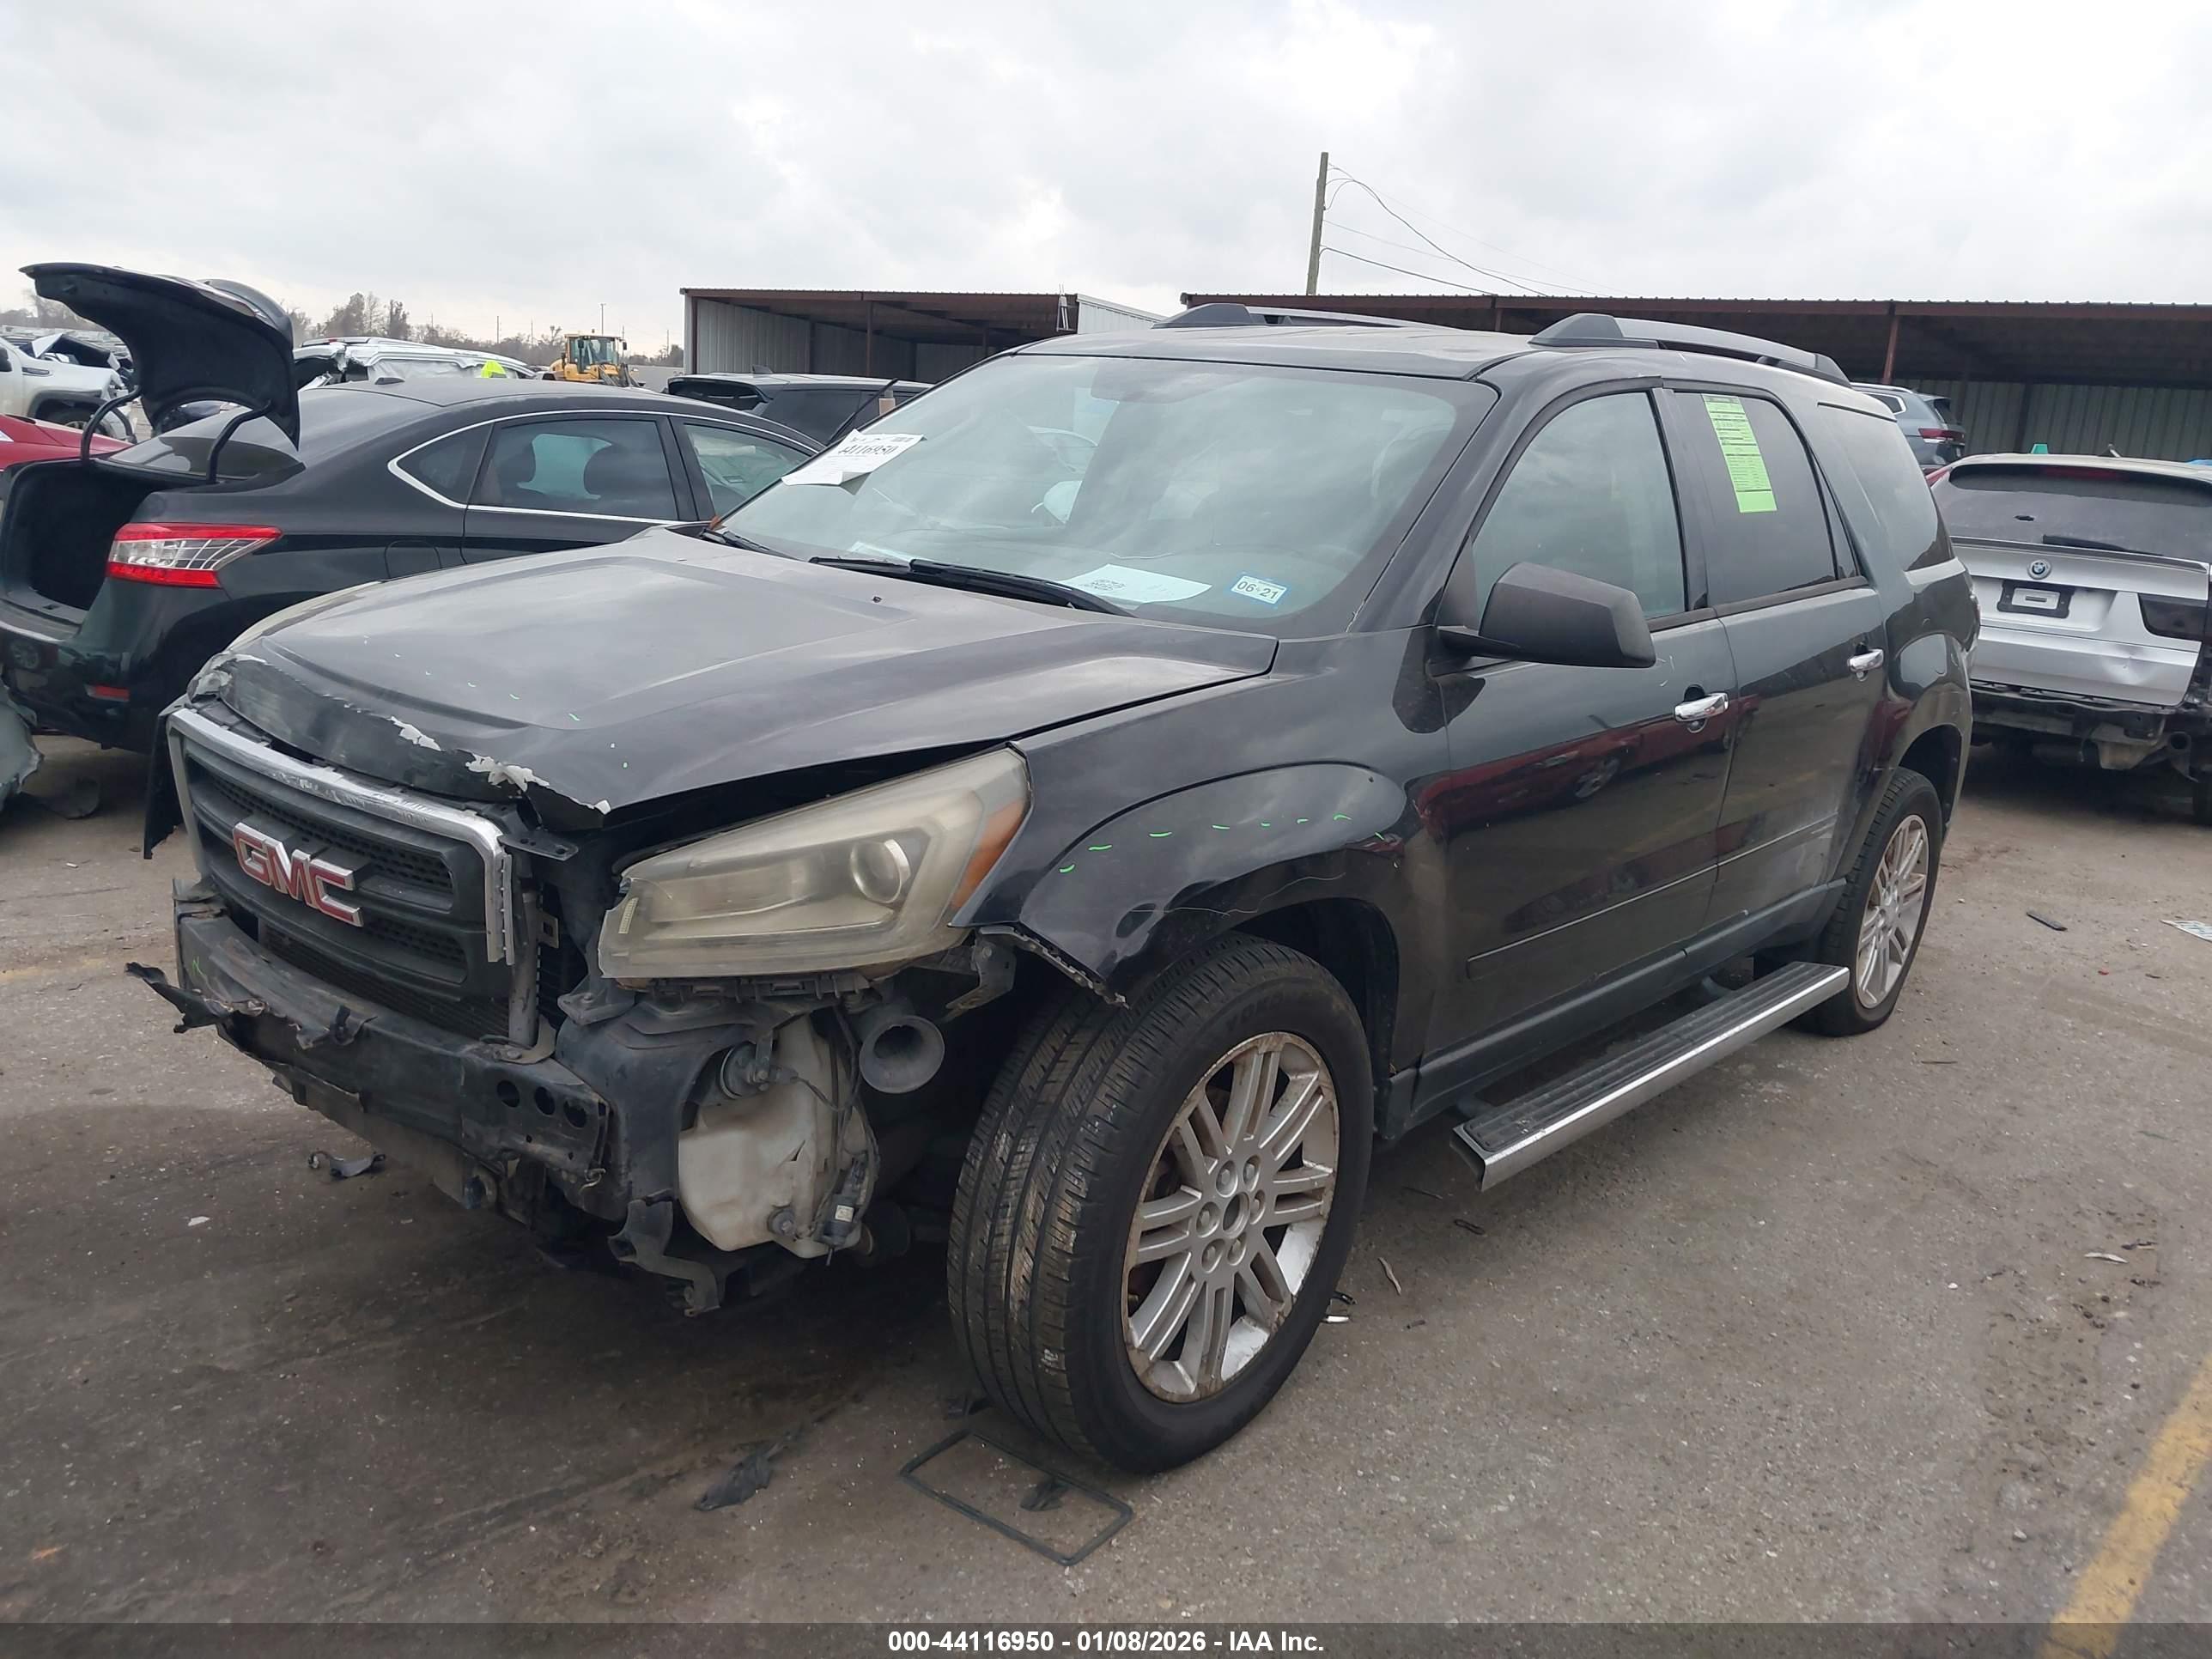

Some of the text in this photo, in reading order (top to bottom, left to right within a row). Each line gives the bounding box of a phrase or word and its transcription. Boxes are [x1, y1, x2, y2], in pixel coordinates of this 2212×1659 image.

[1237, 581, 1257, 592] 06
[1259, 587, 1279, 599] 21
[233, 822, 363, 927] GMC
